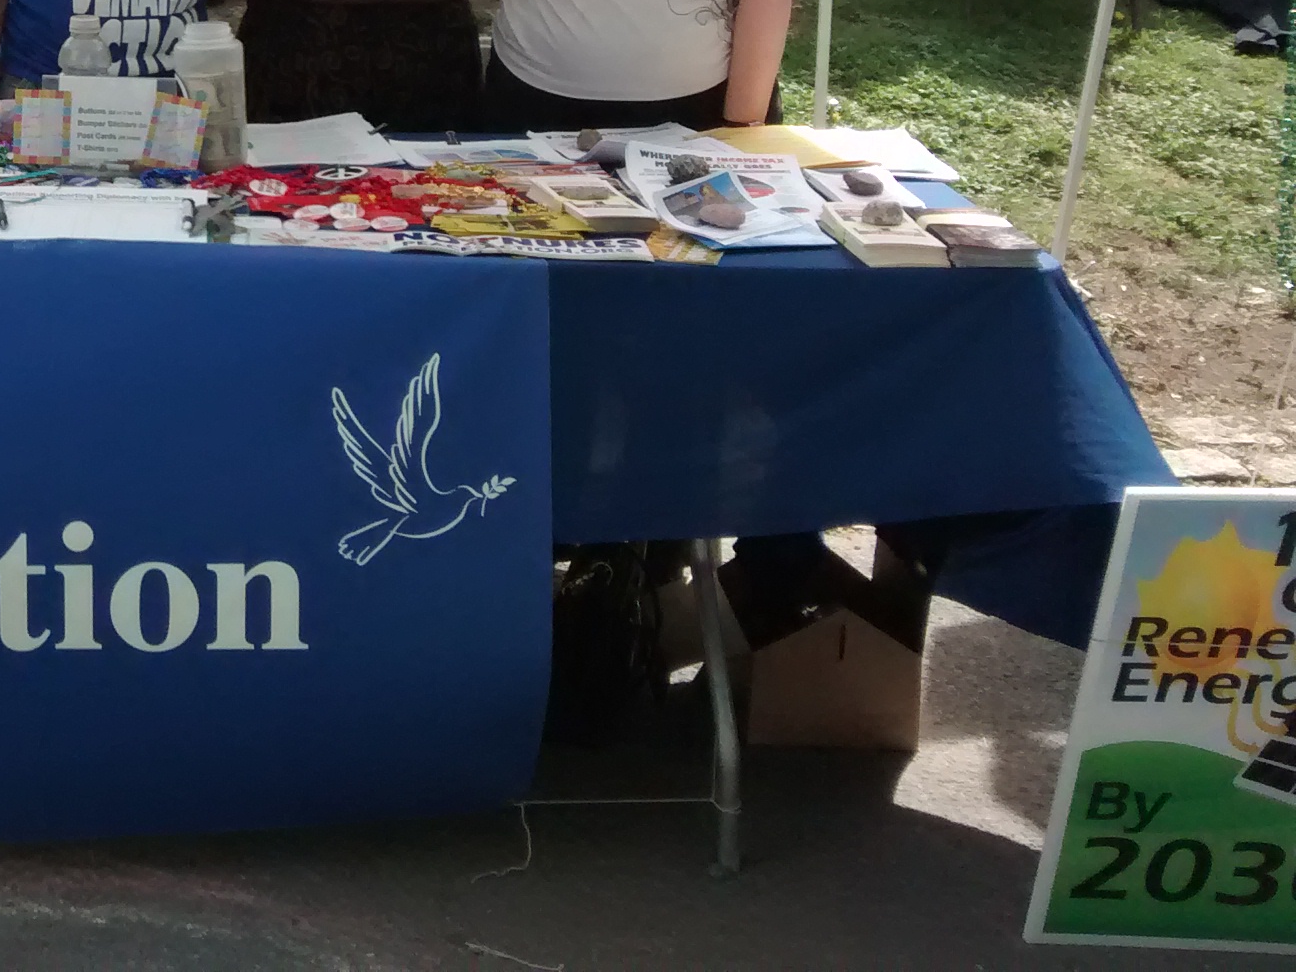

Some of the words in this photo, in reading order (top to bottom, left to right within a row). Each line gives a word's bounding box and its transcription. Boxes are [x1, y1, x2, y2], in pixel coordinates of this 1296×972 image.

[394, 232, 461, 245] NO
[502, 237, 643, 248] NUKES
[1121, 616, 1296, 660] Rene
[1085, 781, 1172, 833] By
[1069, 837, 1296, 906] 203
